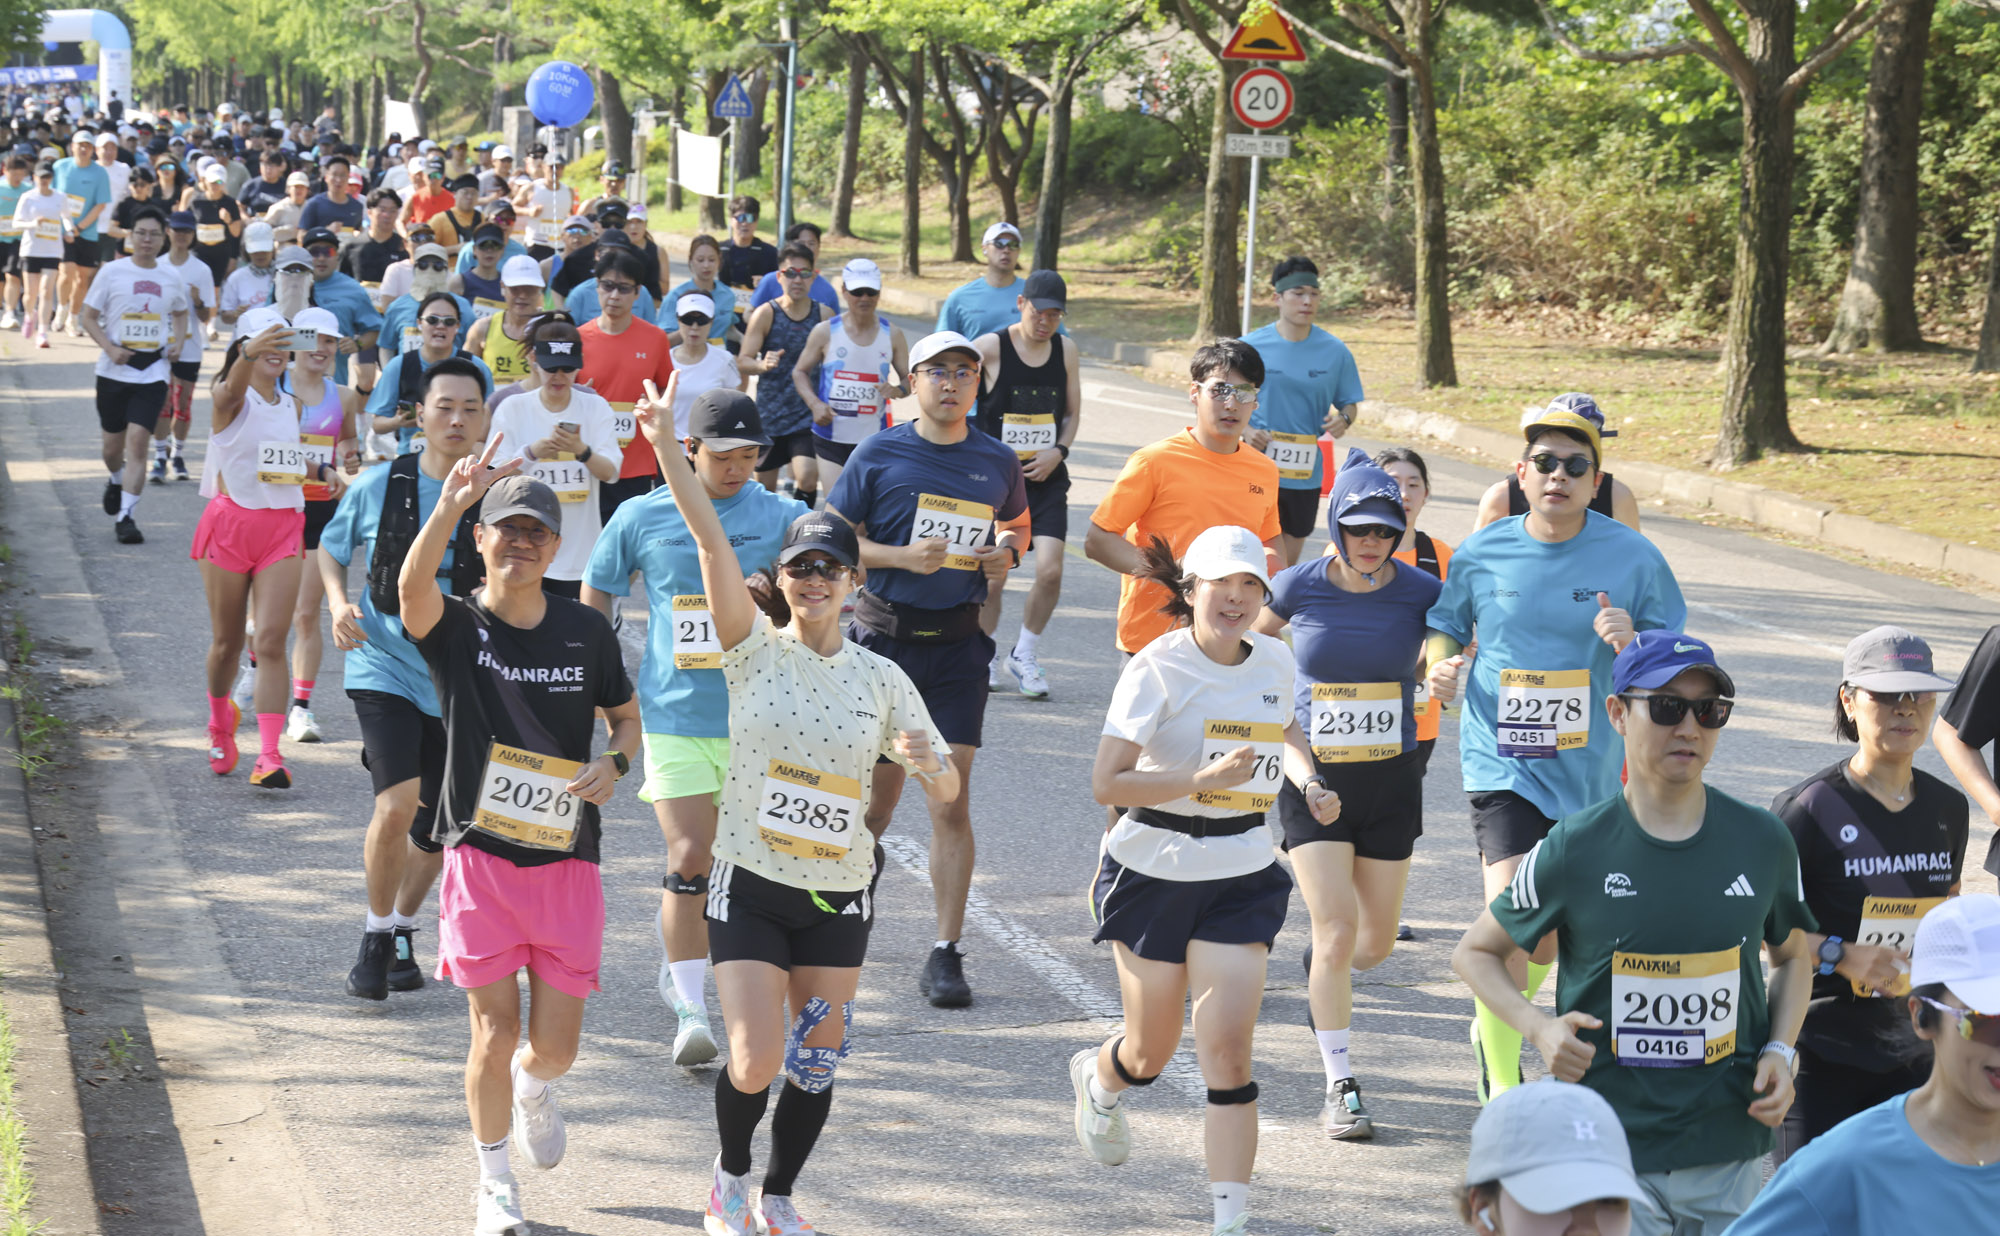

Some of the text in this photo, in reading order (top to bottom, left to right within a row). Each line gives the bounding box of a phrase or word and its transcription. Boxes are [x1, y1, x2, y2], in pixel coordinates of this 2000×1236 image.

[1247, 87, 1278, 110] 20
[1231, 140, 1257, 152] 30m
[124, 325, 160, 337] 1216
[496, 356, 512, 372] 한
[836, 385, 876, 400] 5633
[614, 418, 632, 432] 29
[1007, 430, 1051, 444] 2372
[1272, 448, 1310, 464] 1211
[533, 468, 586, 485] 2114
[918, 518, 983, 547] 2317
[955, 558, 964, 566] 10
[678, 598, 708, 607] 시사저
[680, 620, 713, 643] 21
[477, 650, 584, 682] HUMANRACE
[1506, 673, 1545, 686] 시사저널
[1318, 687, 1358, 698] 시사저널
[1505, 698, 1582, 722] 2278
[1318, 711, 1395, 735] 2349
[1210, 724, 1252, 738] 시사저널
[1510, 731, 1545, 743] 0451
[1568, 736, 1583, 745] km
[1368, 747, 1397, 758] 10 km
[498, 750, 545, 771] 시사저널
[774, 764, 821, 787] 시사저널
[489, 776, 573, 817] 2026
[1251, 797, 1264, 808] 10
[766, 792, 849, 833] 2385
[536, 830, 565, 845] 10 km
[812, 846, 841, 858] 10 km
[1870, 903, 1917, 916] 시사저널
[1621, 957, 1681, 975] 시사저널
[1622, 988, 1731, 1026] 2098
[1636, 1039, 1689, 1056] 0416
[1706, 1046, 1714, 1057] 0
[798, 1049, 842, 1064] BB TAP
[1573, 1120, 1597, 1140] H
